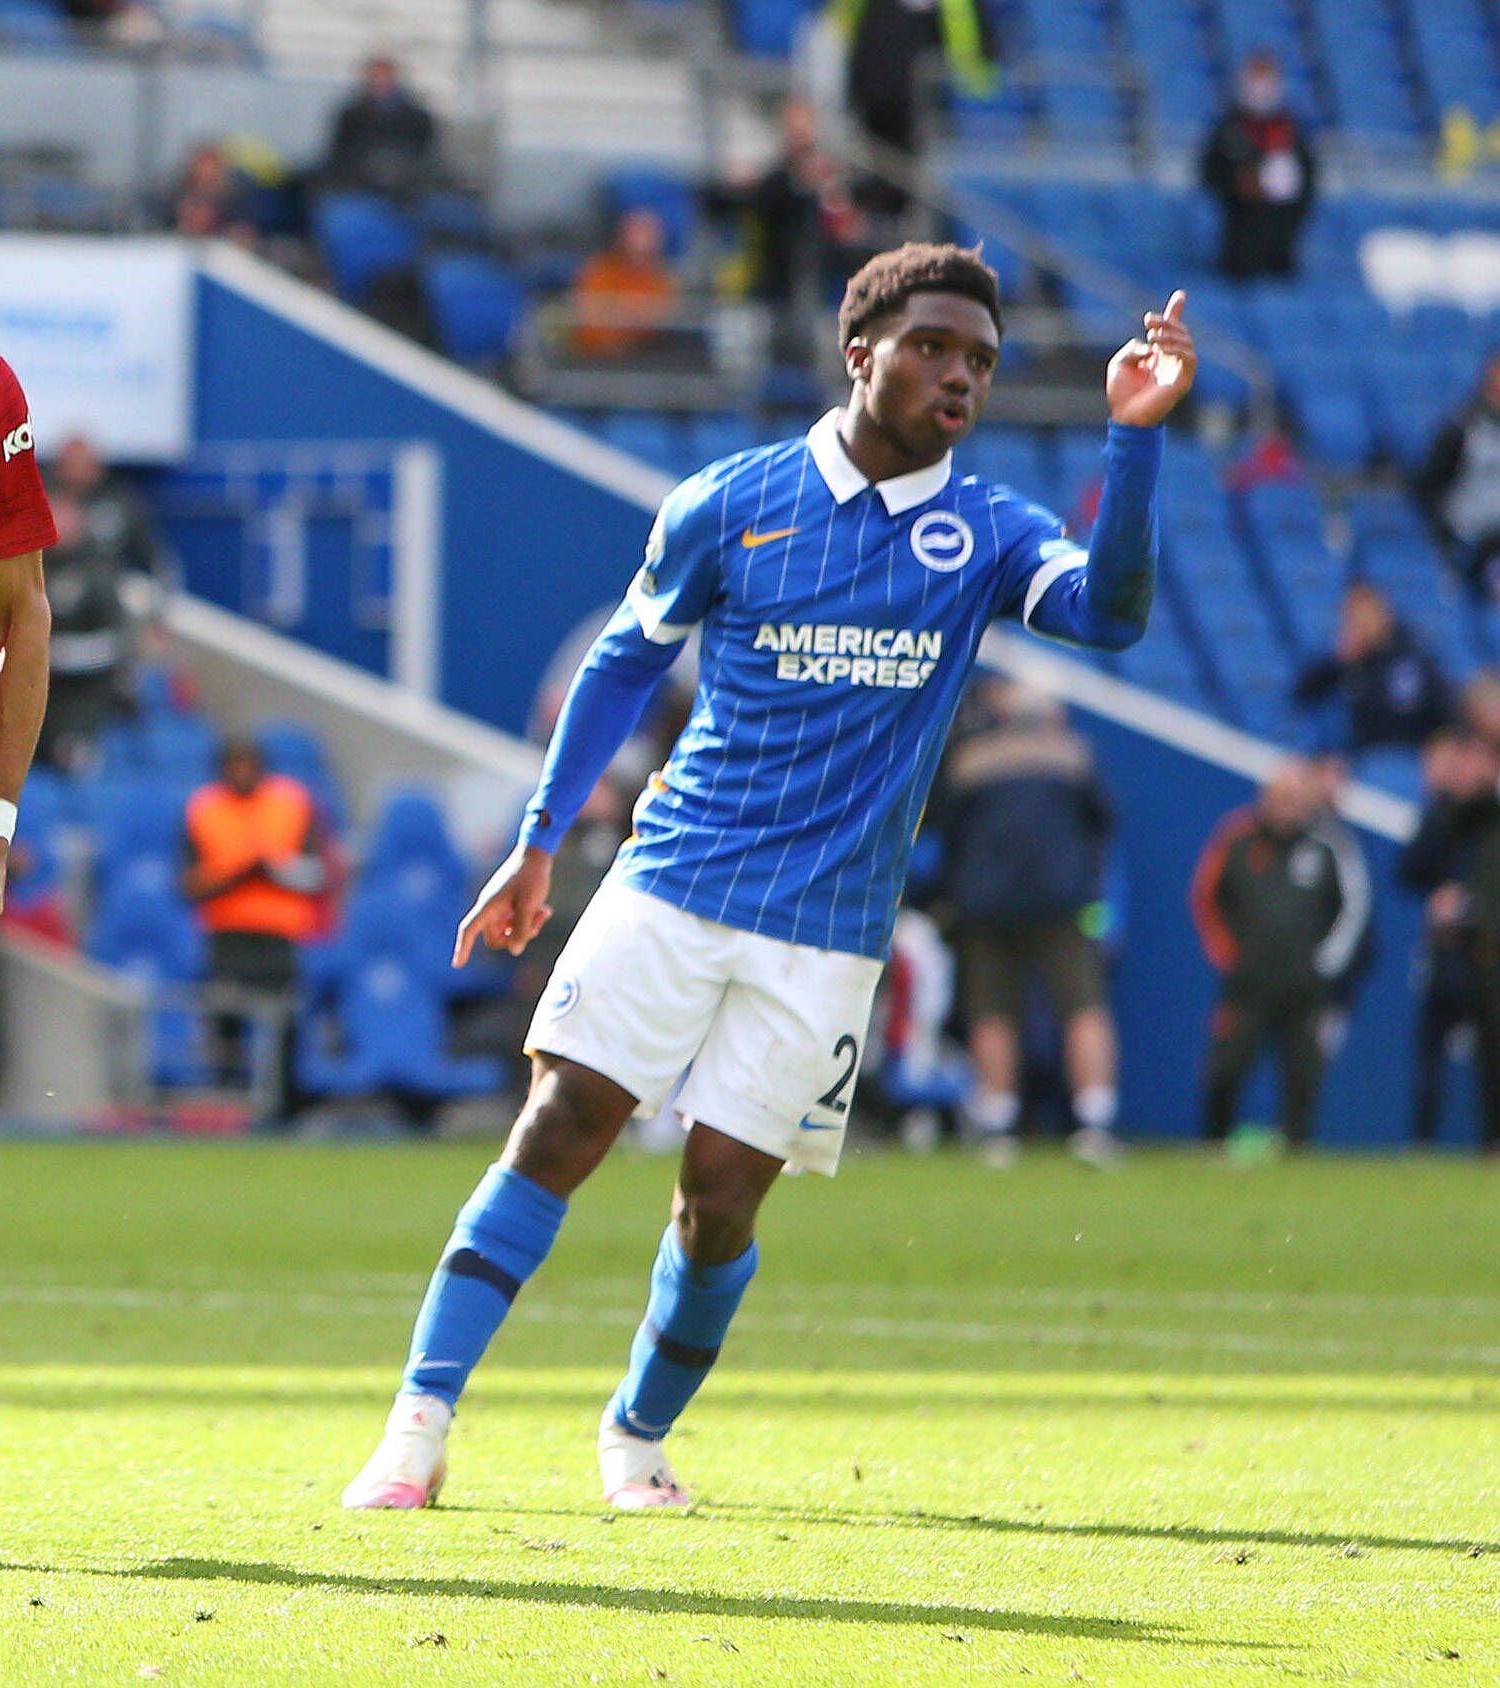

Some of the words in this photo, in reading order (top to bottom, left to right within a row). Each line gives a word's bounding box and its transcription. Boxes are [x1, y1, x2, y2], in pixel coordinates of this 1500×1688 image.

[3, 421, 33, 463] KO
[752, 623, 943, 660] AMERICAN
[816, 1033, 858, 1114] 2
